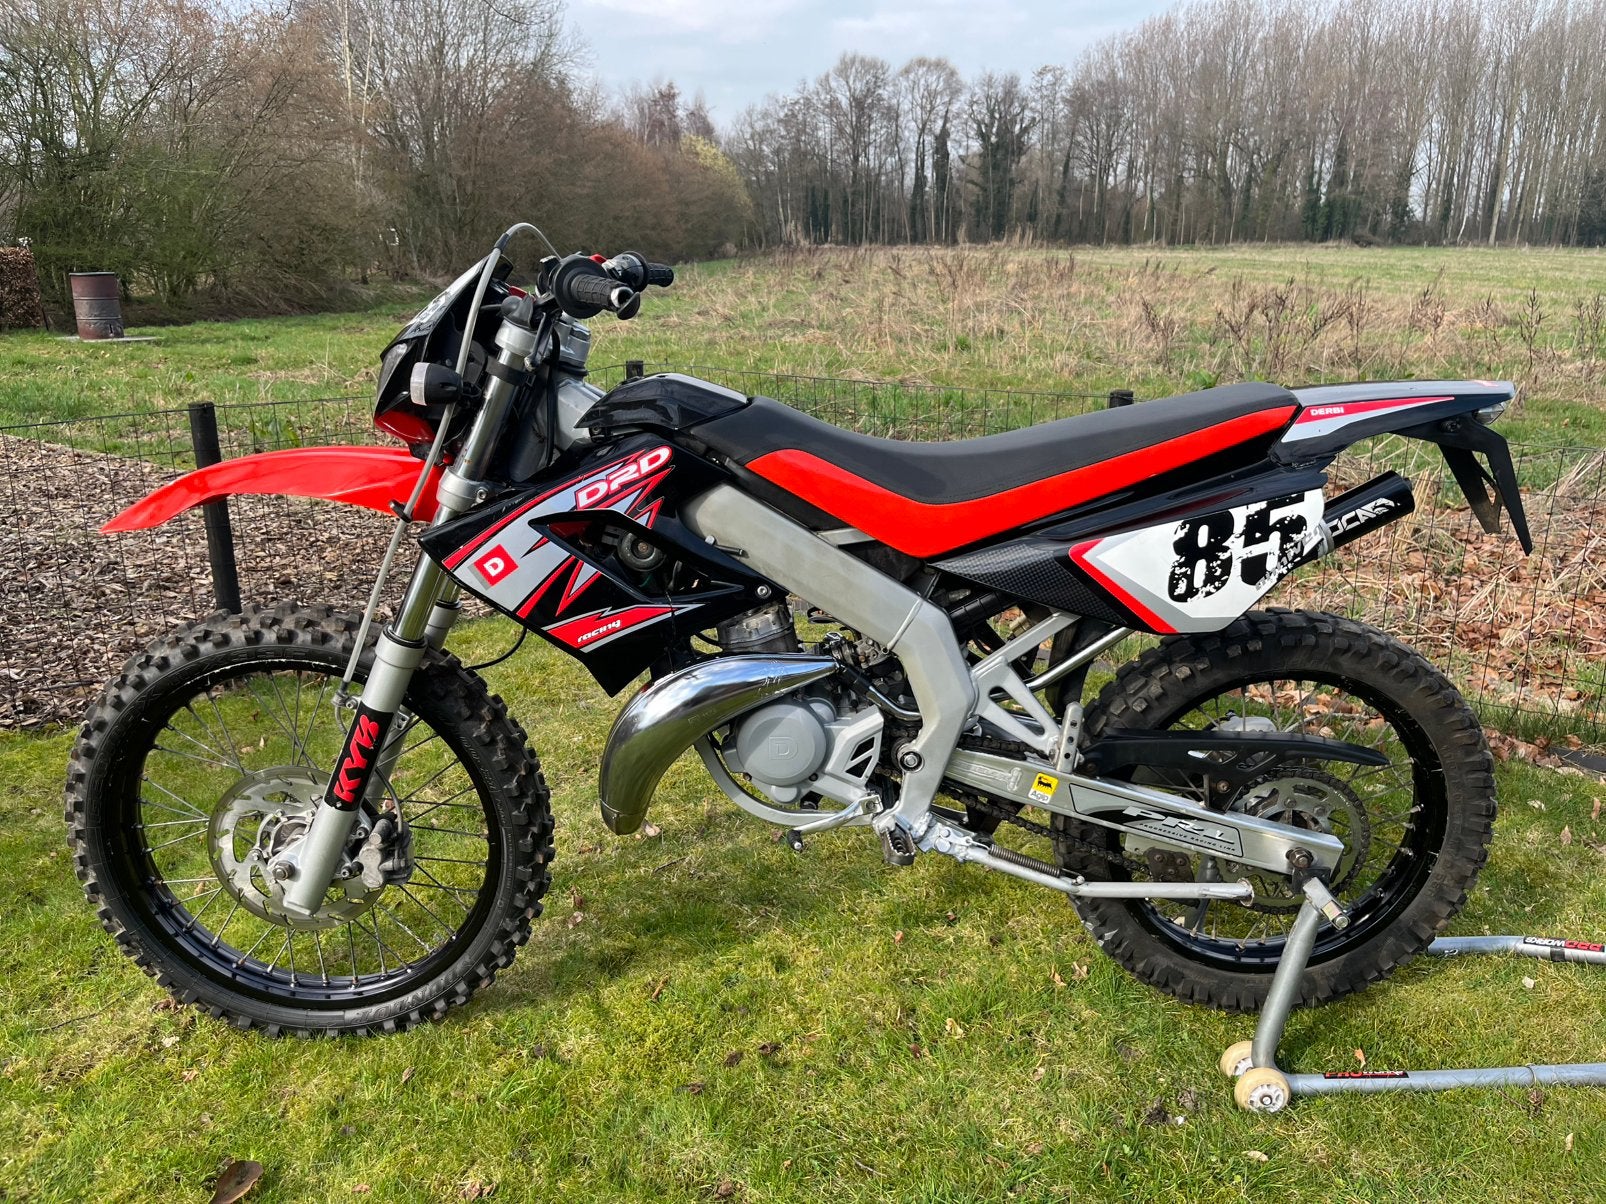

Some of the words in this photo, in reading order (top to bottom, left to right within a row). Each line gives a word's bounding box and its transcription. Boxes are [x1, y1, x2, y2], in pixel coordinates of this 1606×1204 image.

[575, 445, 672, 509] DRD
[483, 556, 505, 577] D
[1167, 491, 1308, 603] 85
[333, 714, 380, 804] KYB
[1029, 789, 1050, 803] Agip
